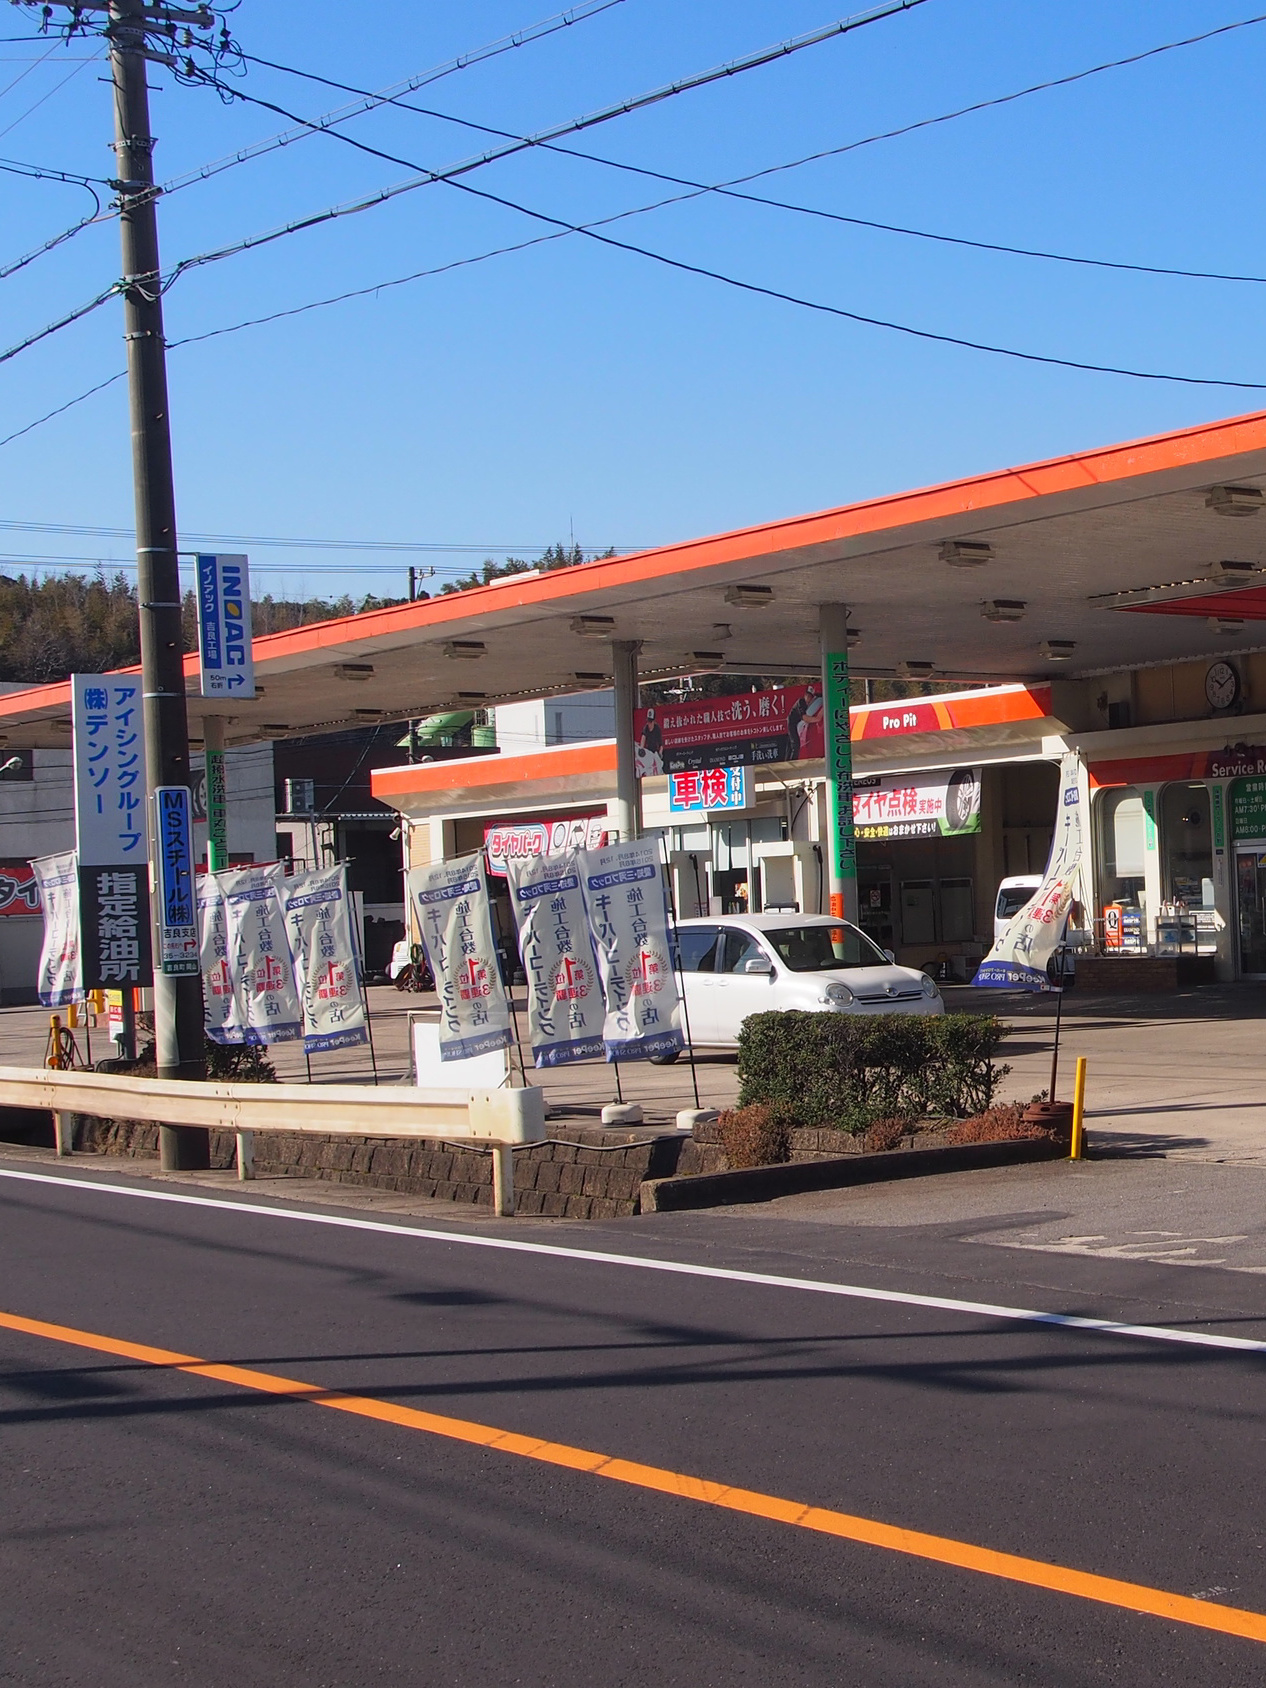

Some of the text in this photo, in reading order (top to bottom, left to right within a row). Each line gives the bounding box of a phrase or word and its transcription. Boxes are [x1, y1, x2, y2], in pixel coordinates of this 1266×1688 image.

[203, 565, 217, 660] イノアック 吉良工場
[883, 713, 917, 729] Pro Pit
[114, 687, 141, 852] アイシングループ
[673, 768, 729, 808] 車検
[730, 767, 743, 806] 受付中
[1212, 761, 1254, 777] Service
[853, 787, 942, 819] タイヤ点検 実施中
[96, 872, 140, 982] 指定給油所
[163, 928, 196, 938] 吉良支店
